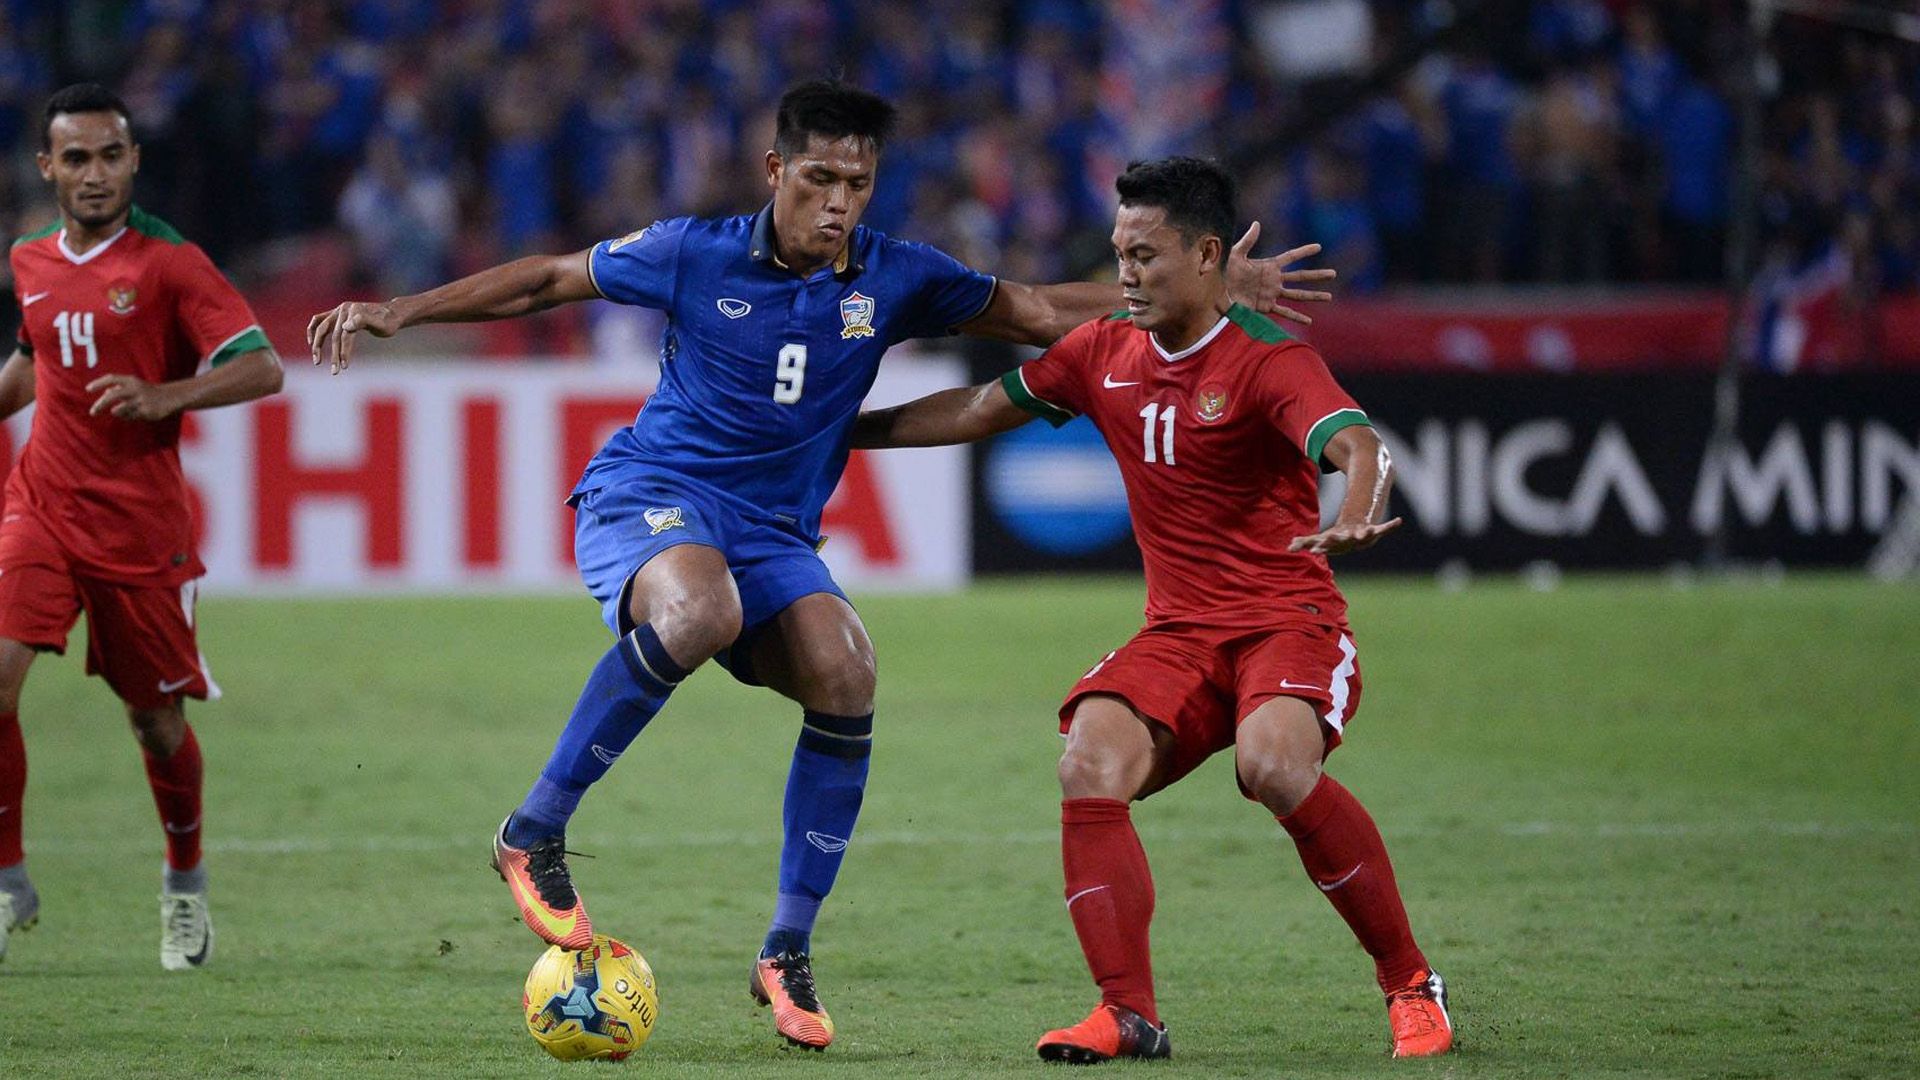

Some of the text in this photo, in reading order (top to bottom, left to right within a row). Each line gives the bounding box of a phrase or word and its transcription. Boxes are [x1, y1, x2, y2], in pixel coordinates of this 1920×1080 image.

[53, 311, 98, 368] 14
[773, 343, 807, 405] 9
[1139, 402, 1177, 466] 11
[1319, 418, 1667, 537] NICA
